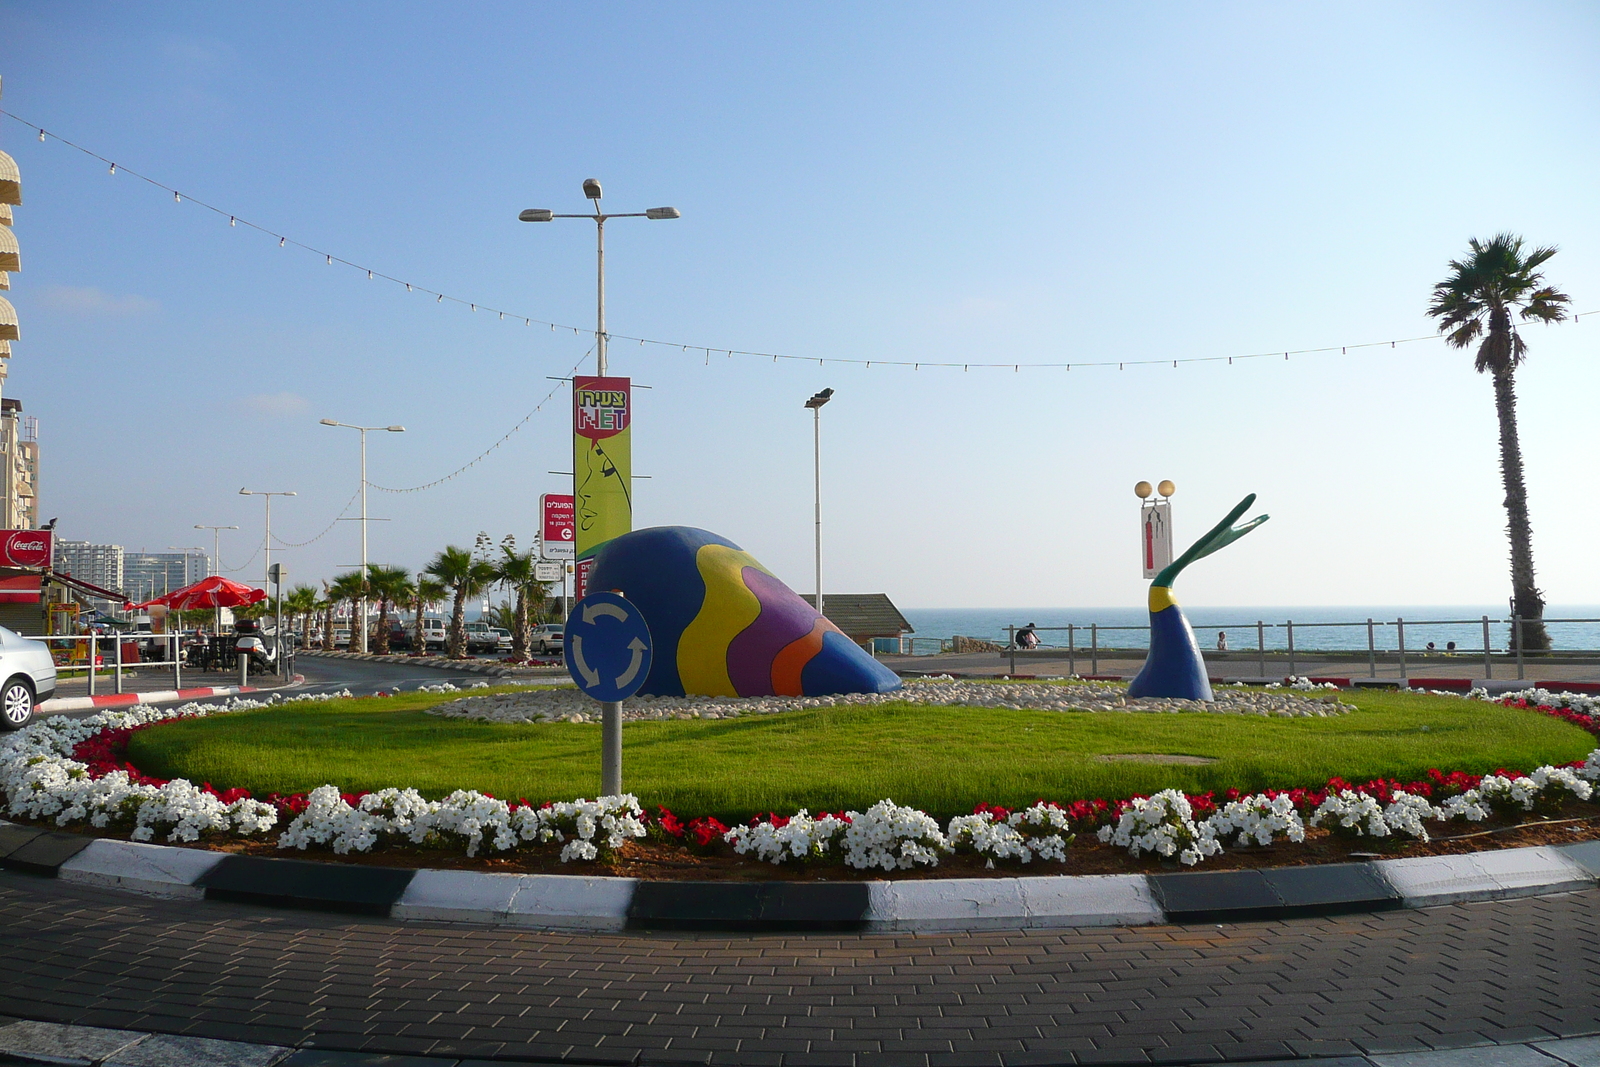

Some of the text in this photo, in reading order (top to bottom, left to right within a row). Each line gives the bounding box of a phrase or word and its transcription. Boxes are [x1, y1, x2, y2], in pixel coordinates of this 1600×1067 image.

[579, 409, 626, 429] NET
[546, 501, 573, 509] הפועלים
[13, 540, 44, 551] Coca-Cola
